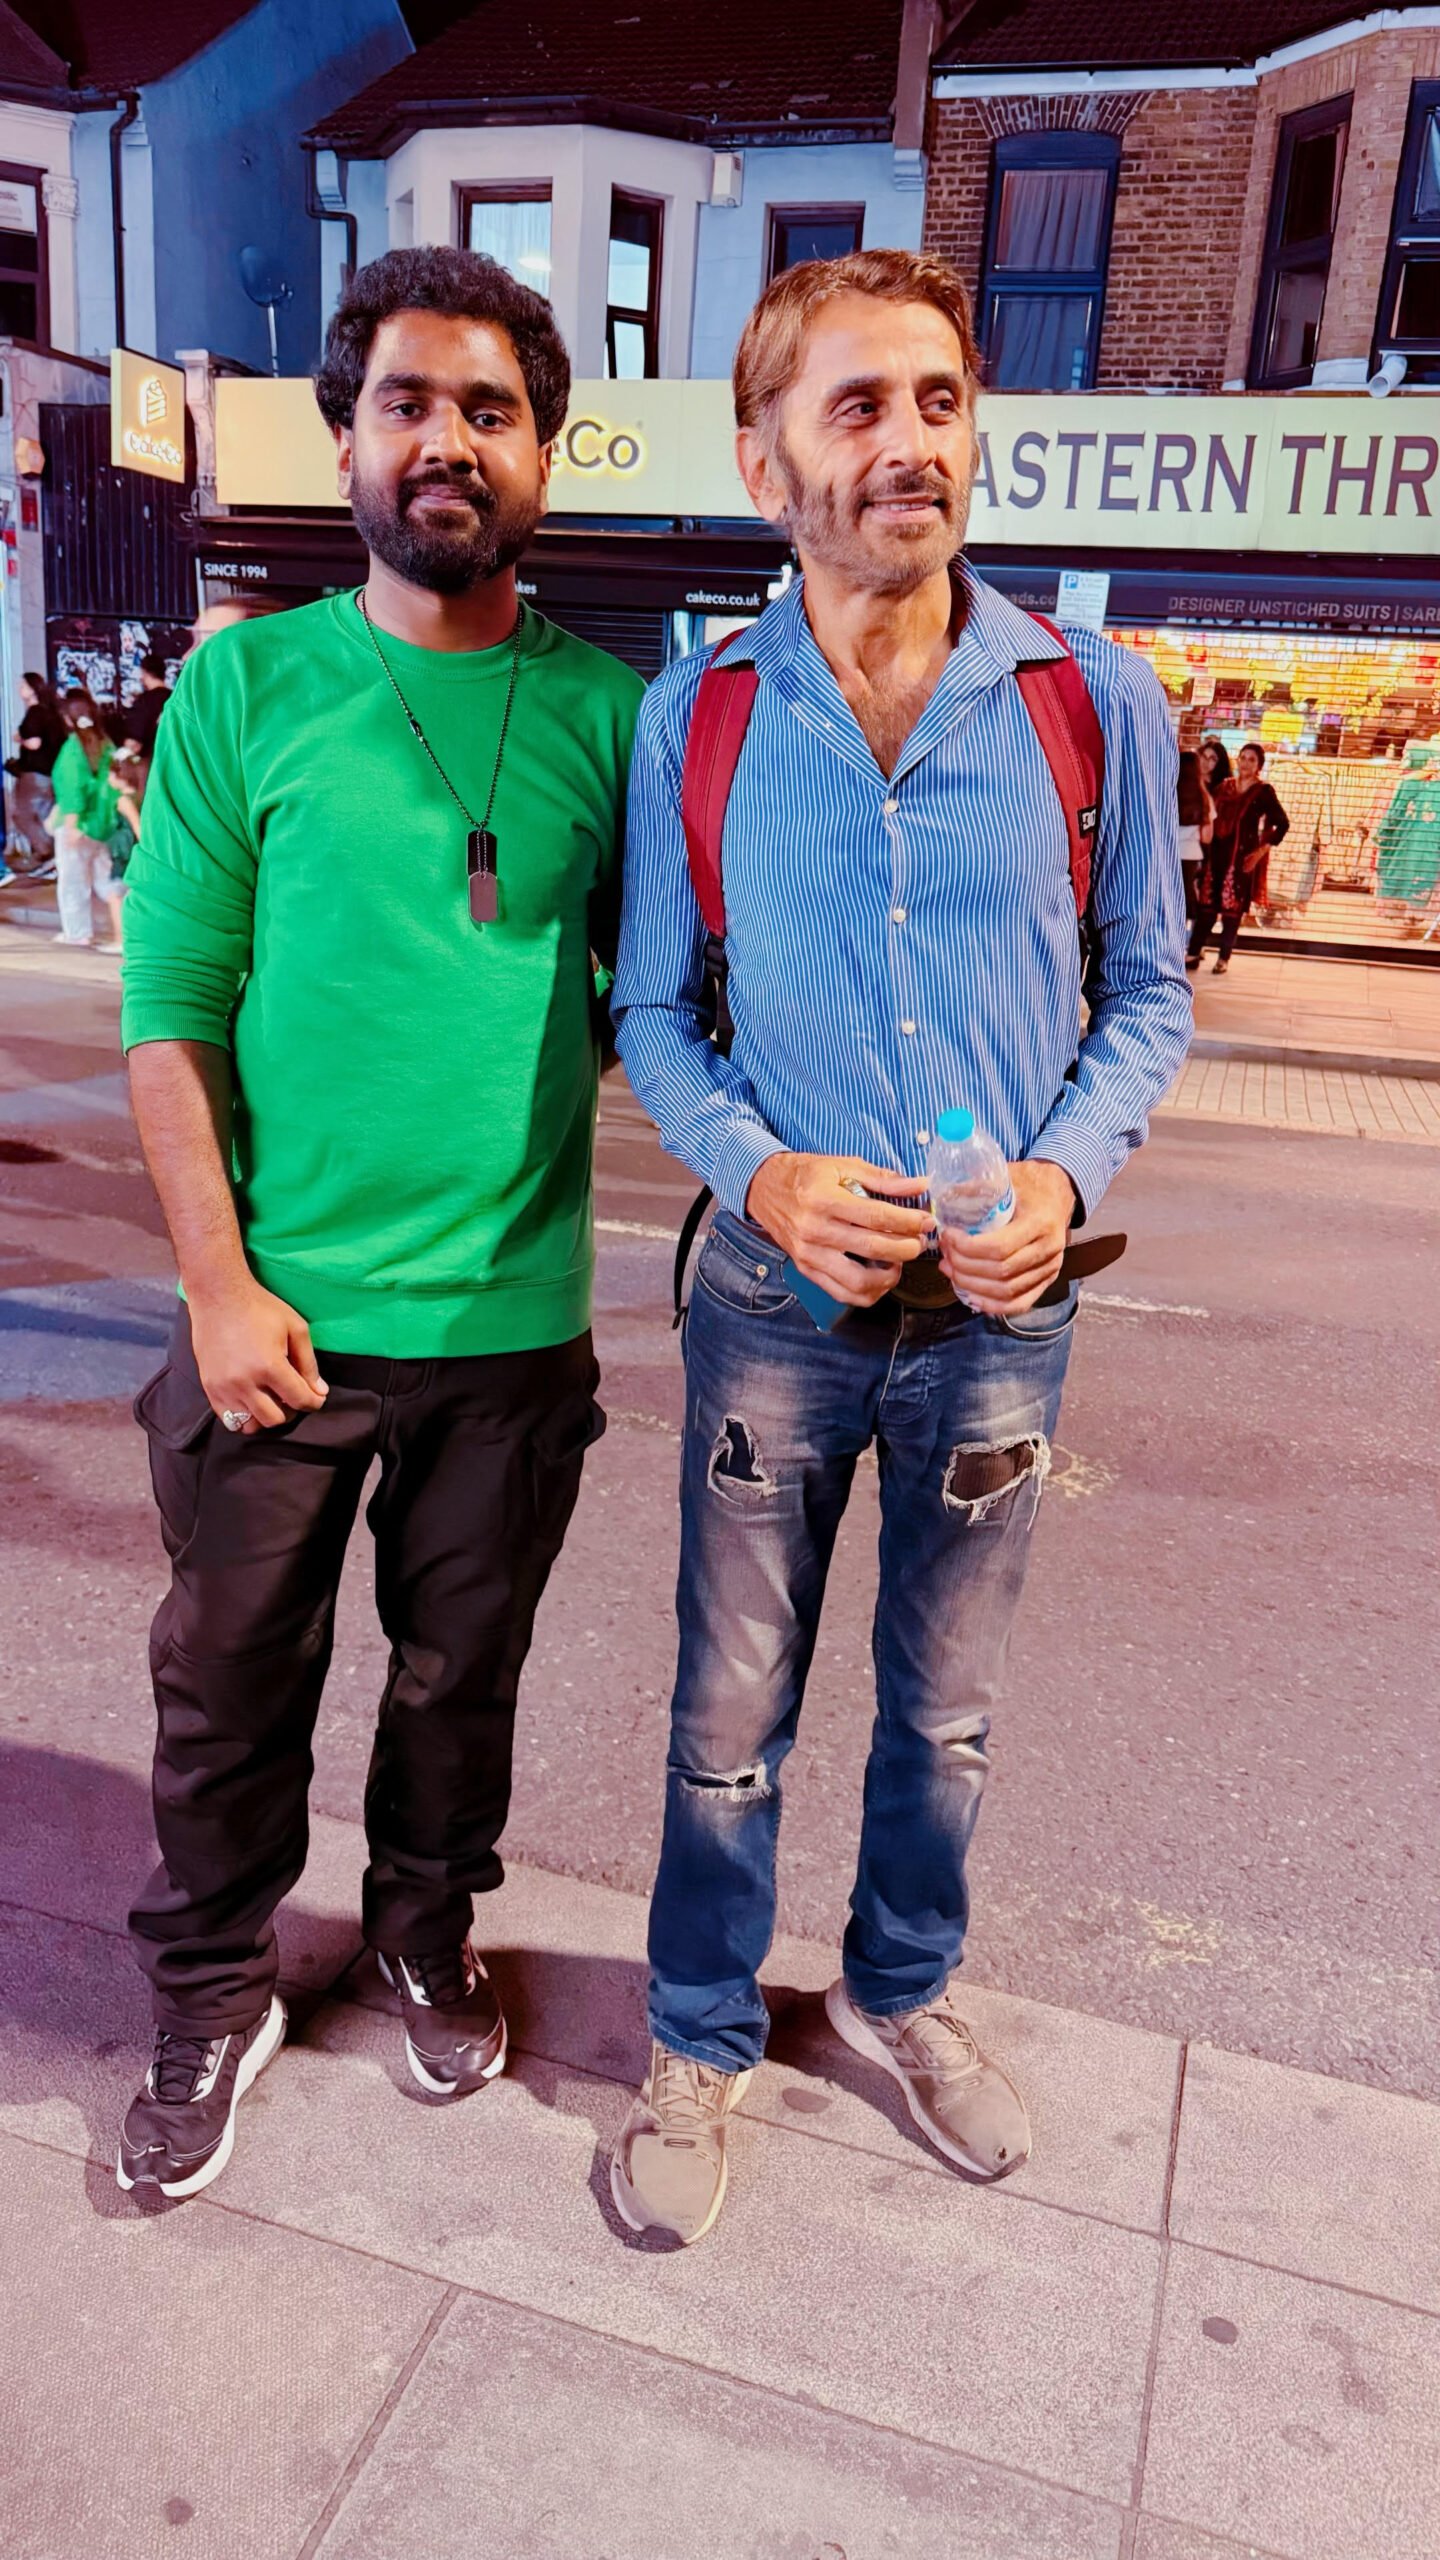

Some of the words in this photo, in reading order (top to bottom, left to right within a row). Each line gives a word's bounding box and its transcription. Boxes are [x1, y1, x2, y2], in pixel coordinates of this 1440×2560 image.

[1281, 432, 1439, 517] THR
[204, 563, 238, 577] SINCE
[241, 565, 268, 579] 1994
[685, 589, 760, 606] cakeco.co.uk
[1168, 596, 1246, 614] DESIGNER
[1249, 600, 1340, 617] UNSTICHED
[1342, 604, 1392, 620] SUITS
